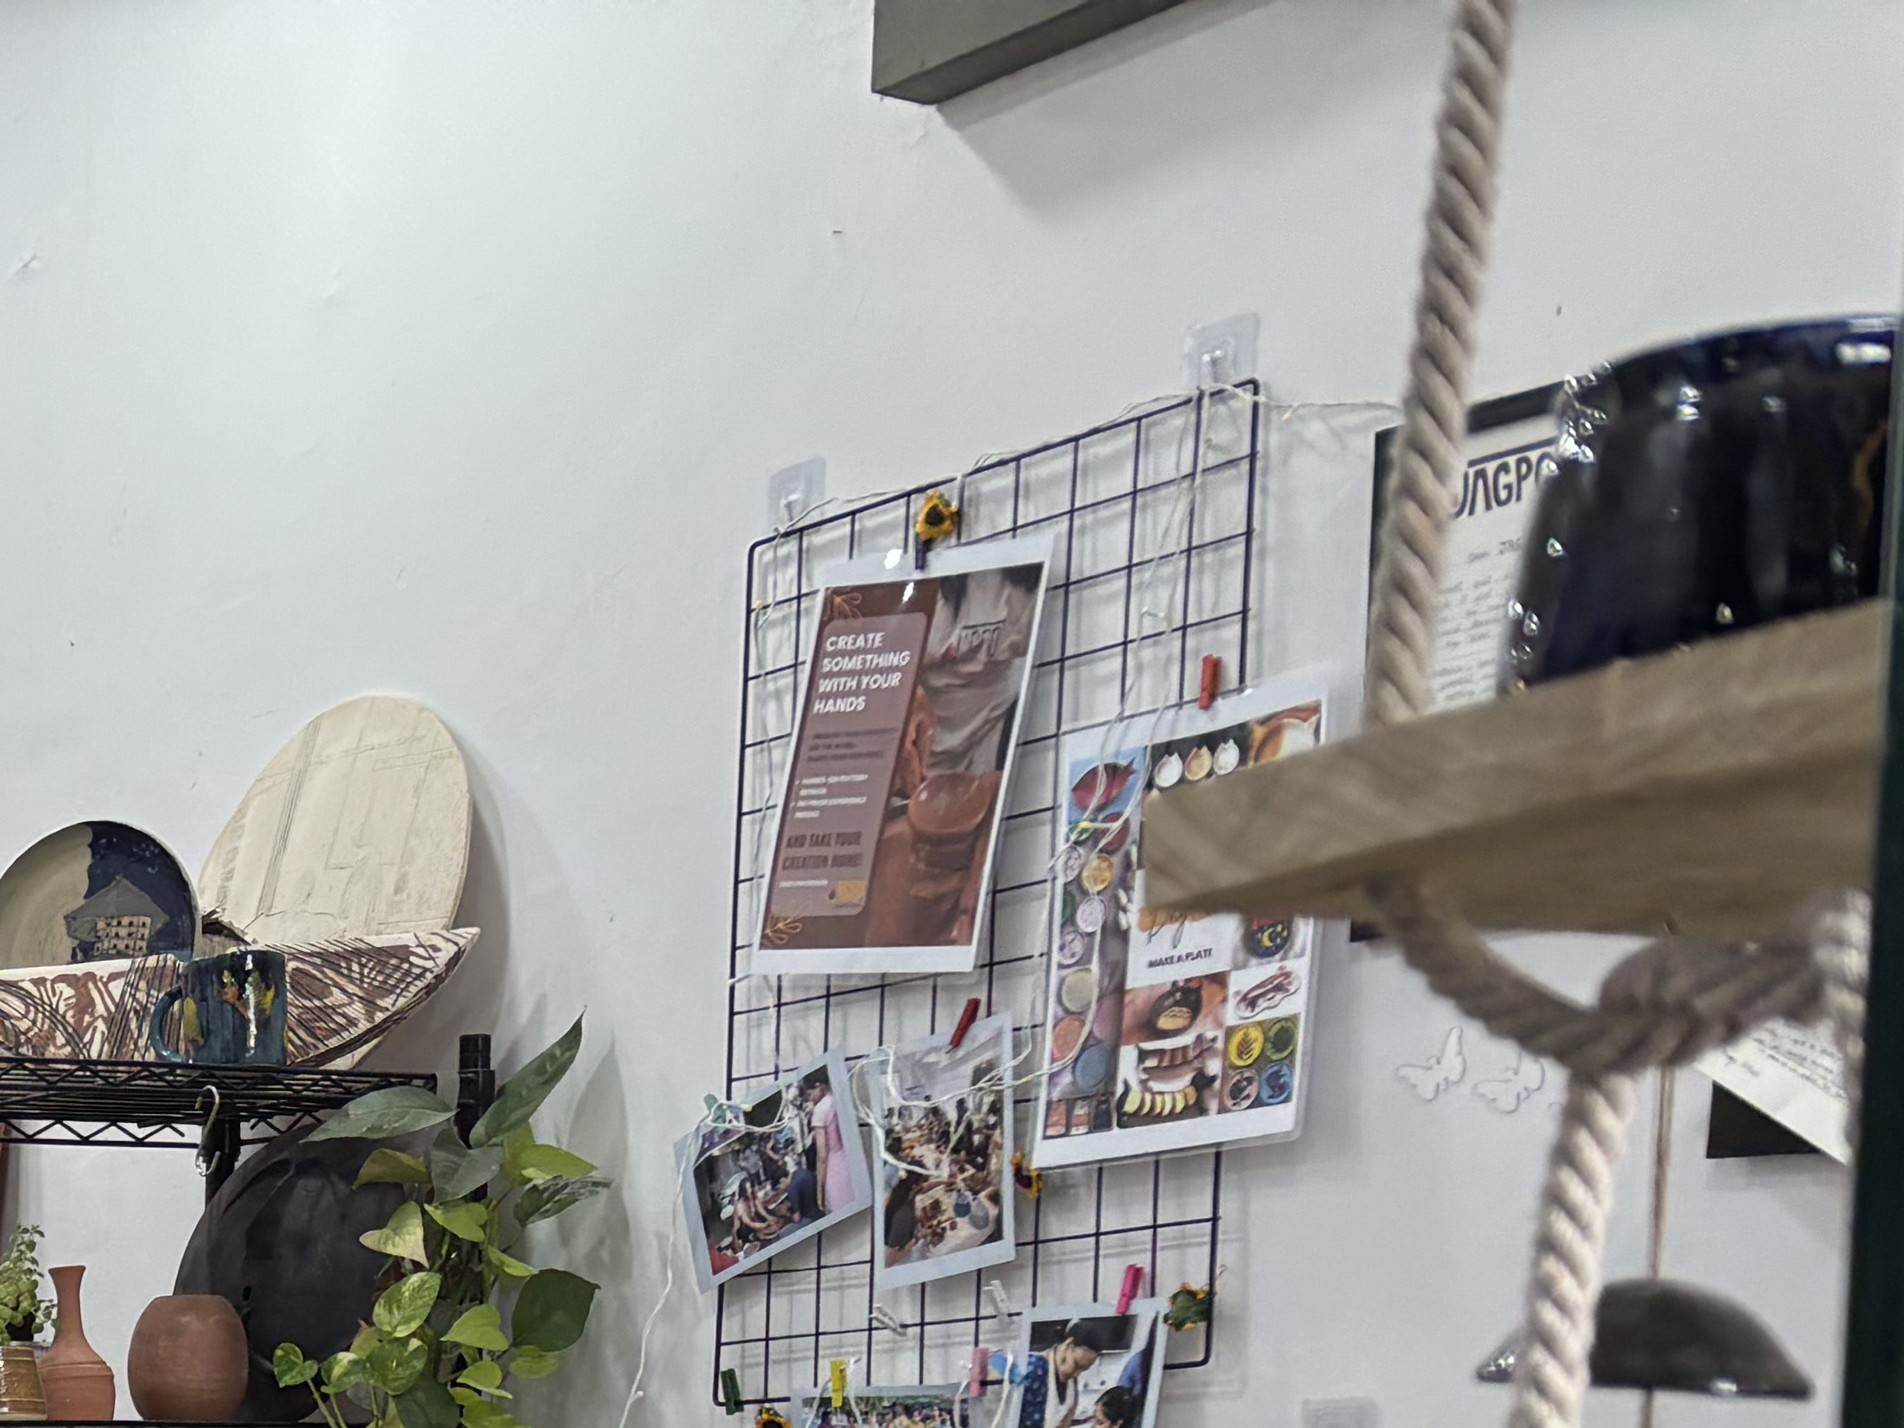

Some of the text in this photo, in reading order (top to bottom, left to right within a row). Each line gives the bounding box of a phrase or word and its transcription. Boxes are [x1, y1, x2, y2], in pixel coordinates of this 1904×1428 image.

[825, 632, 886, 652] CREATE
[821, 650, 911, 673] SOMETHING
[818, 671, 902, 694] WITH YOUR
[813, 696, 866, 714] HANDS
[1147, 954, 1175, 968] MAKE
